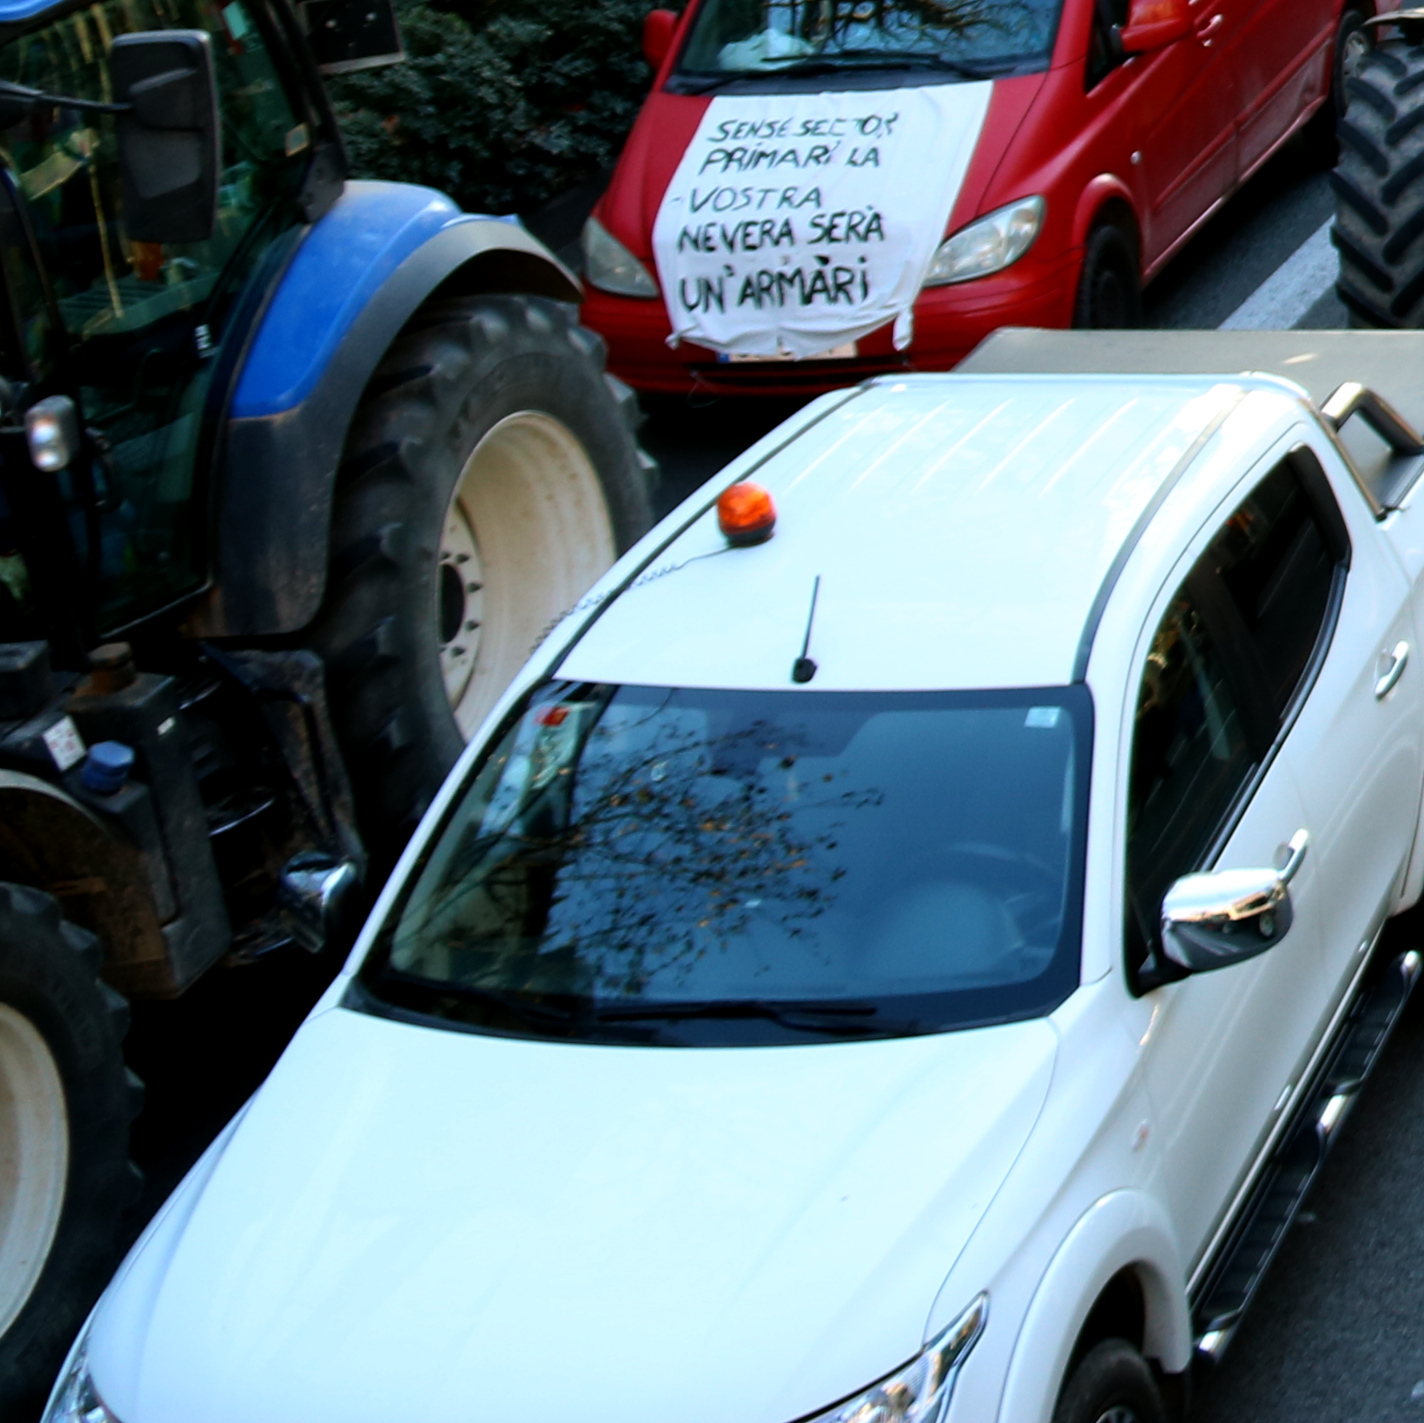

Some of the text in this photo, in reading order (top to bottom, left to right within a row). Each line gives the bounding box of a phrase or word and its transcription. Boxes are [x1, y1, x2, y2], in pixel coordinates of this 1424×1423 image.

[707, 117, 794, 143] SENSE
[845, 146, 880, 167] LA
[690, 186, 822, 214] VOSTRA
[677, 217, 796, 255] NEVERA
